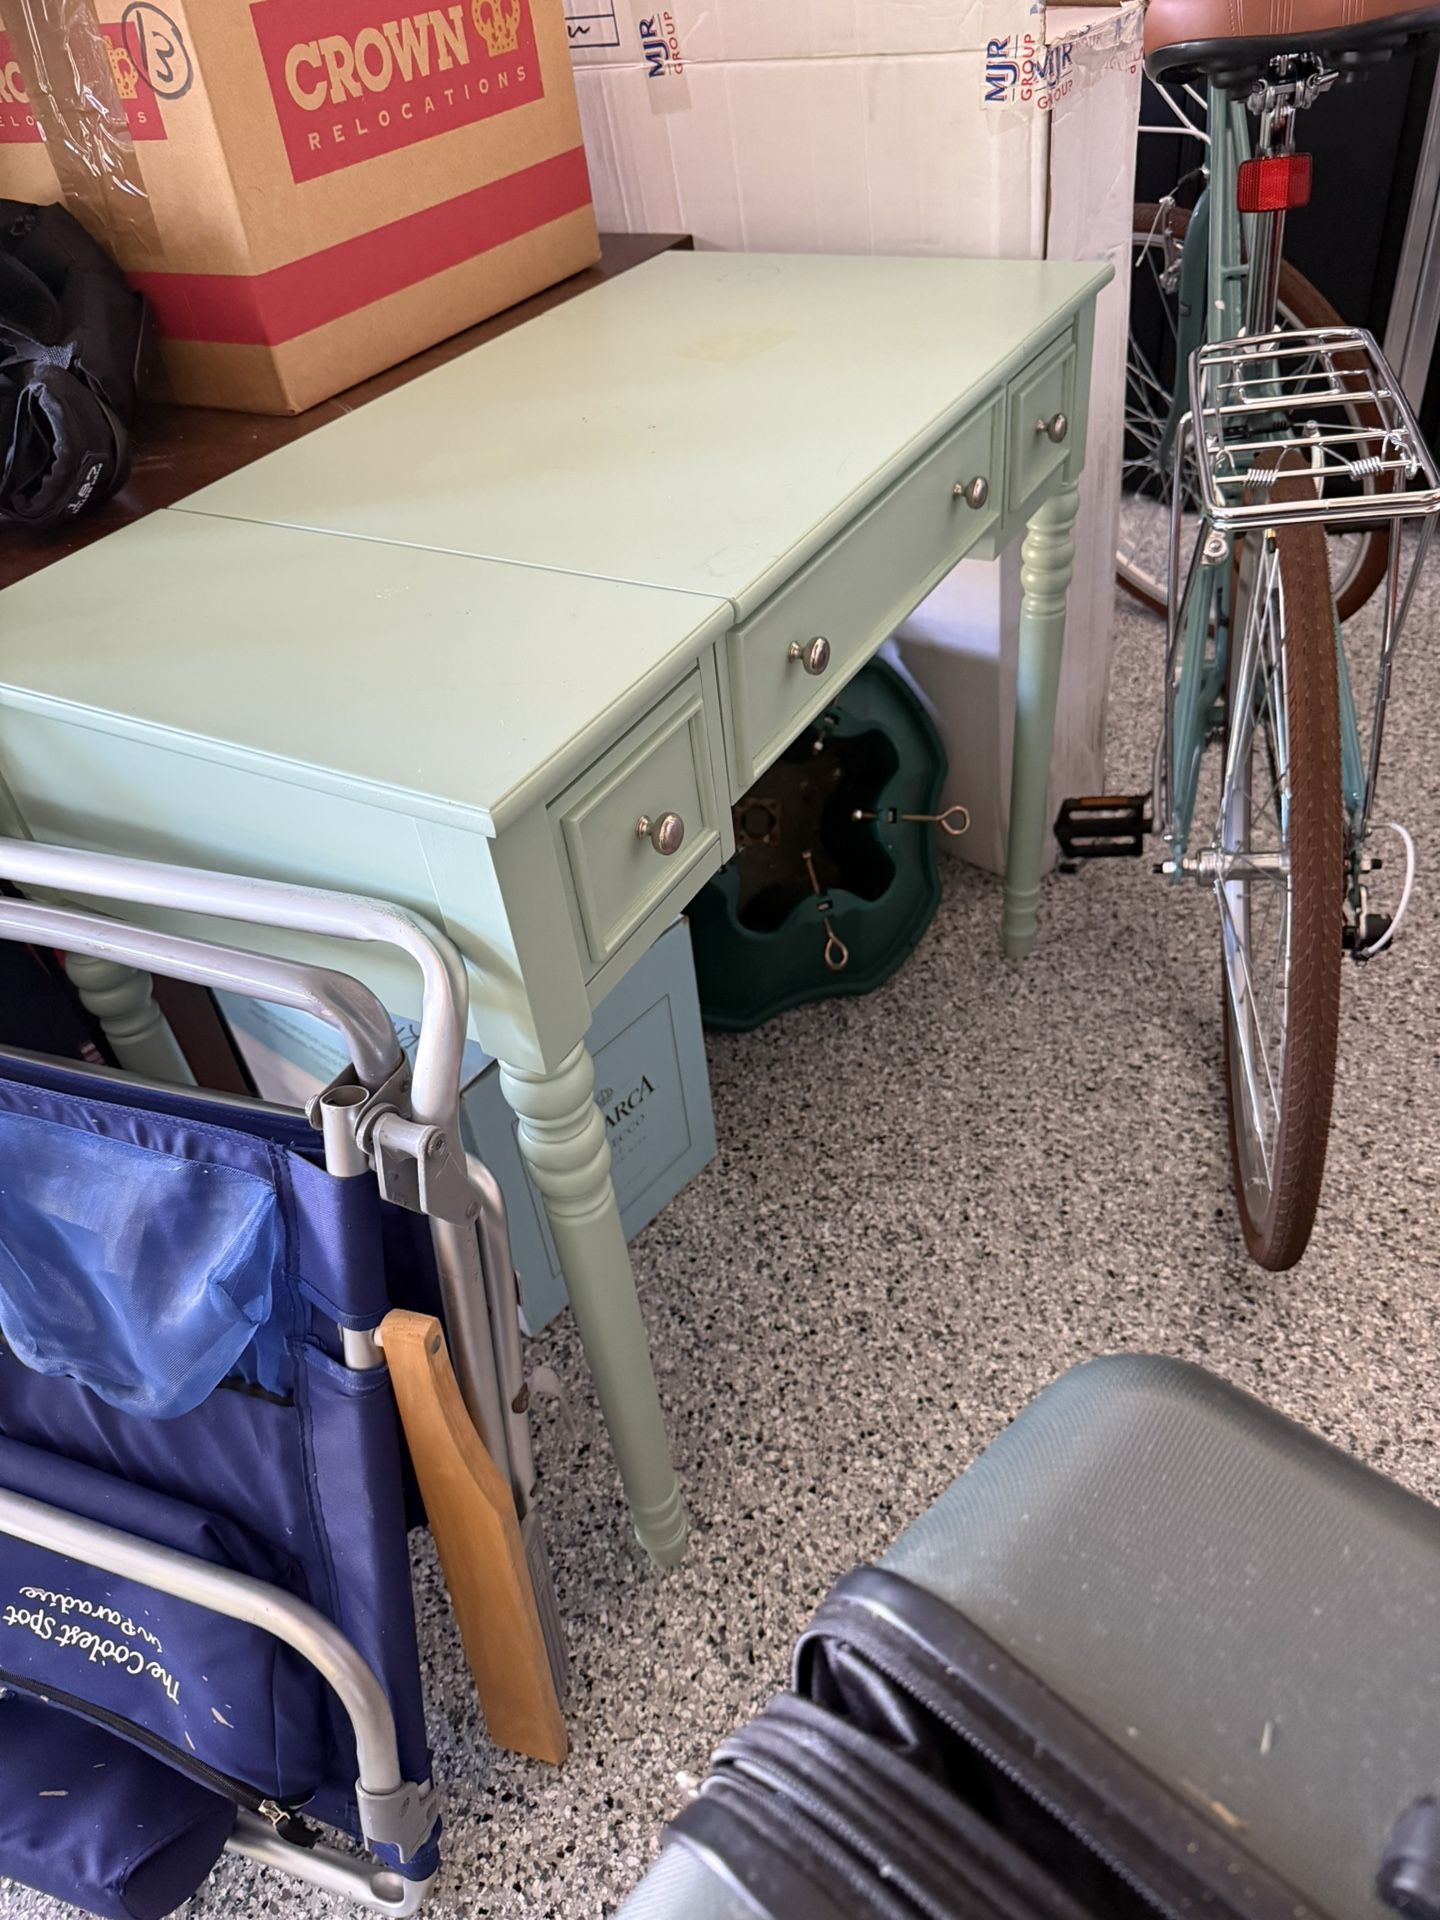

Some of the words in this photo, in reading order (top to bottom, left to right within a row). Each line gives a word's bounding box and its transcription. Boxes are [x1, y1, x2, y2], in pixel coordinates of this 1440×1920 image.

[285, 5, 469, 111] CROWN
[640, 15, 670, 78] MJR
[663, 11, 683, 75] GROUP
[985, 35, 1021, 102] MJR
[1020, 33, 1036, 102] GROUP
[307, 66, 527, 151] RELOCATIONS
[604, 1075, 655, 1128] ARCA
[3, 1605, 56, 1640] Spot
[19, 1586, 137, 1636] Paradise
[137, 1626, 163, 1652] in
[55, 1624, 144, 1675] Coolest
[146, 1661, 180, 1705] The
